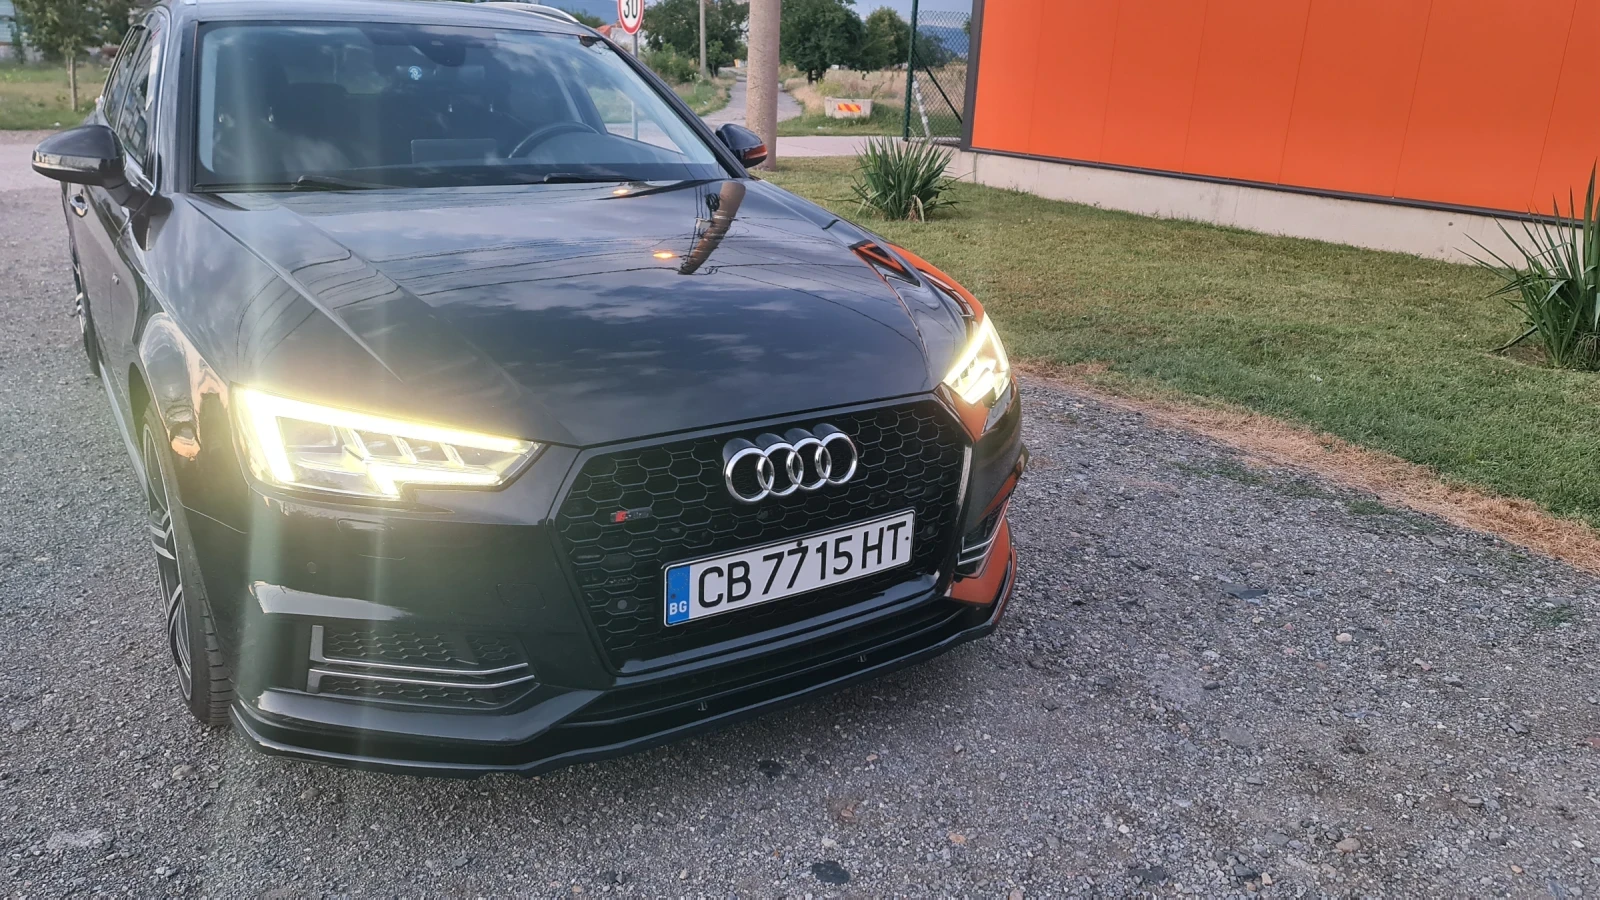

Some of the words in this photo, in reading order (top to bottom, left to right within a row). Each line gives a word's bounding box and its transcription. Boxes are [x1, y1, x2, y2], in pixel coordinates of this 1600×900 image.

[698, 560, 751, 608] CB
[762, 535, 853, 595] 7715
[861, 521, 907, 569] HT
[669, 601, 688, 615] BG
